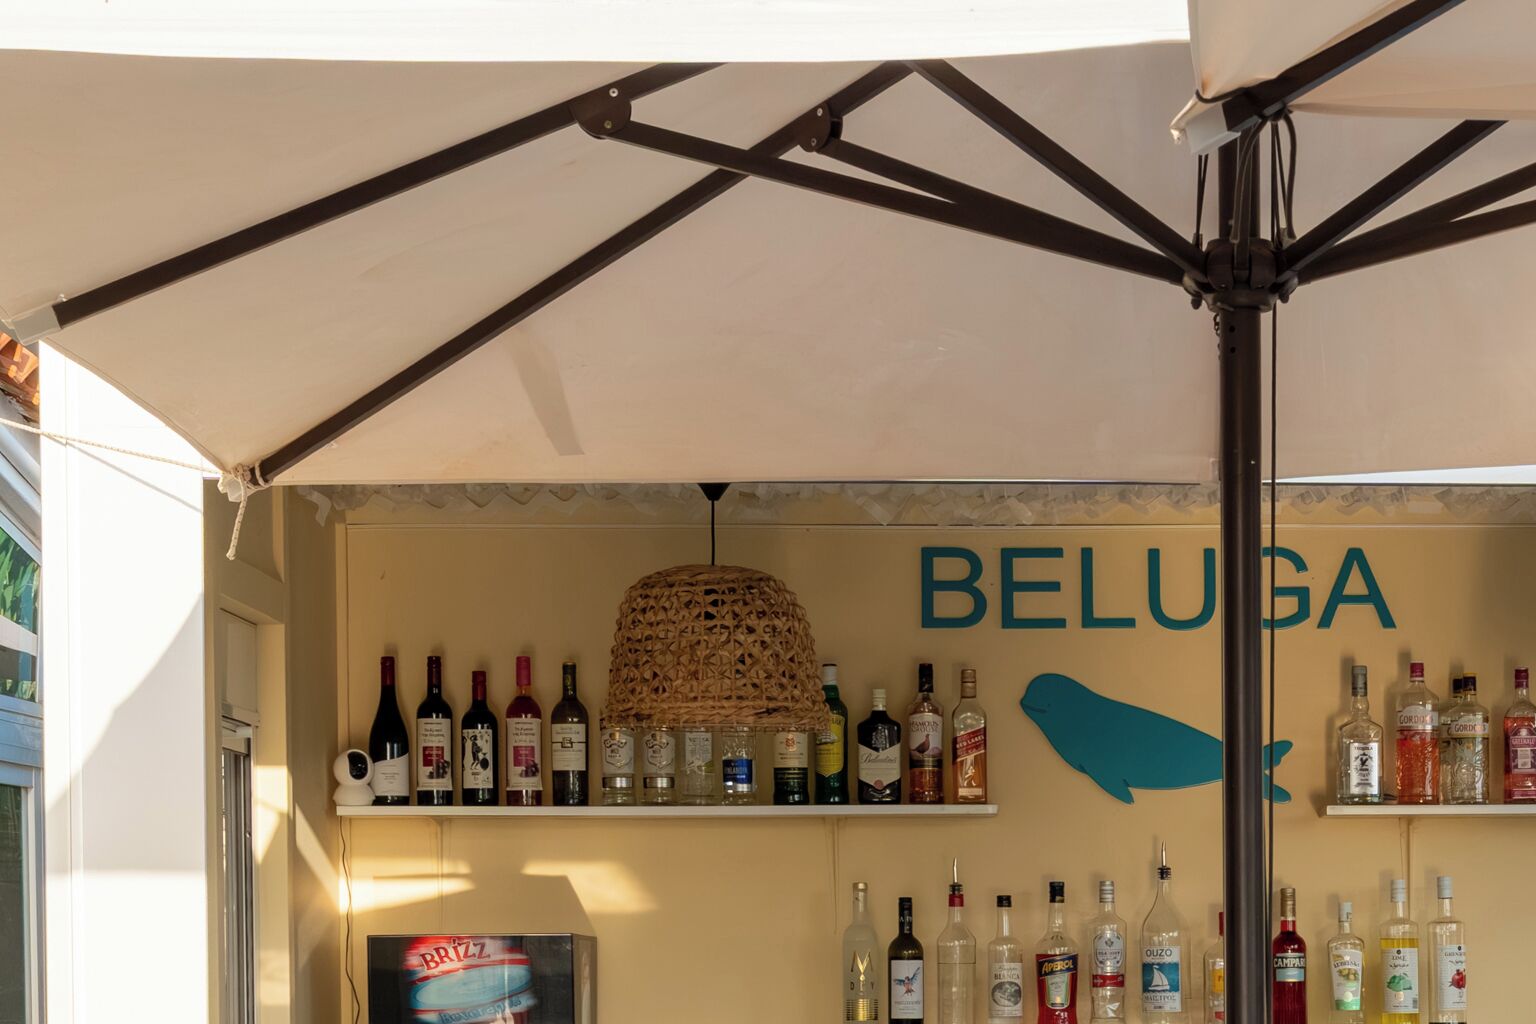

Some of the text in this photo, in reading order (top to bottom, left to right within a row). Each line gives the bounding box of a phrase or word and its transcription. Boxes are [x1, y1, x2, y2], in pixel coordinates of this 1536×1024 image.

[920, 547, 1397, 630] BELUGA
[1145, 948, 1173, 958] OUZO
[1042, 959, 1074, 975] APEROL
[1273, 957, 1306, 968] CAMPAR
